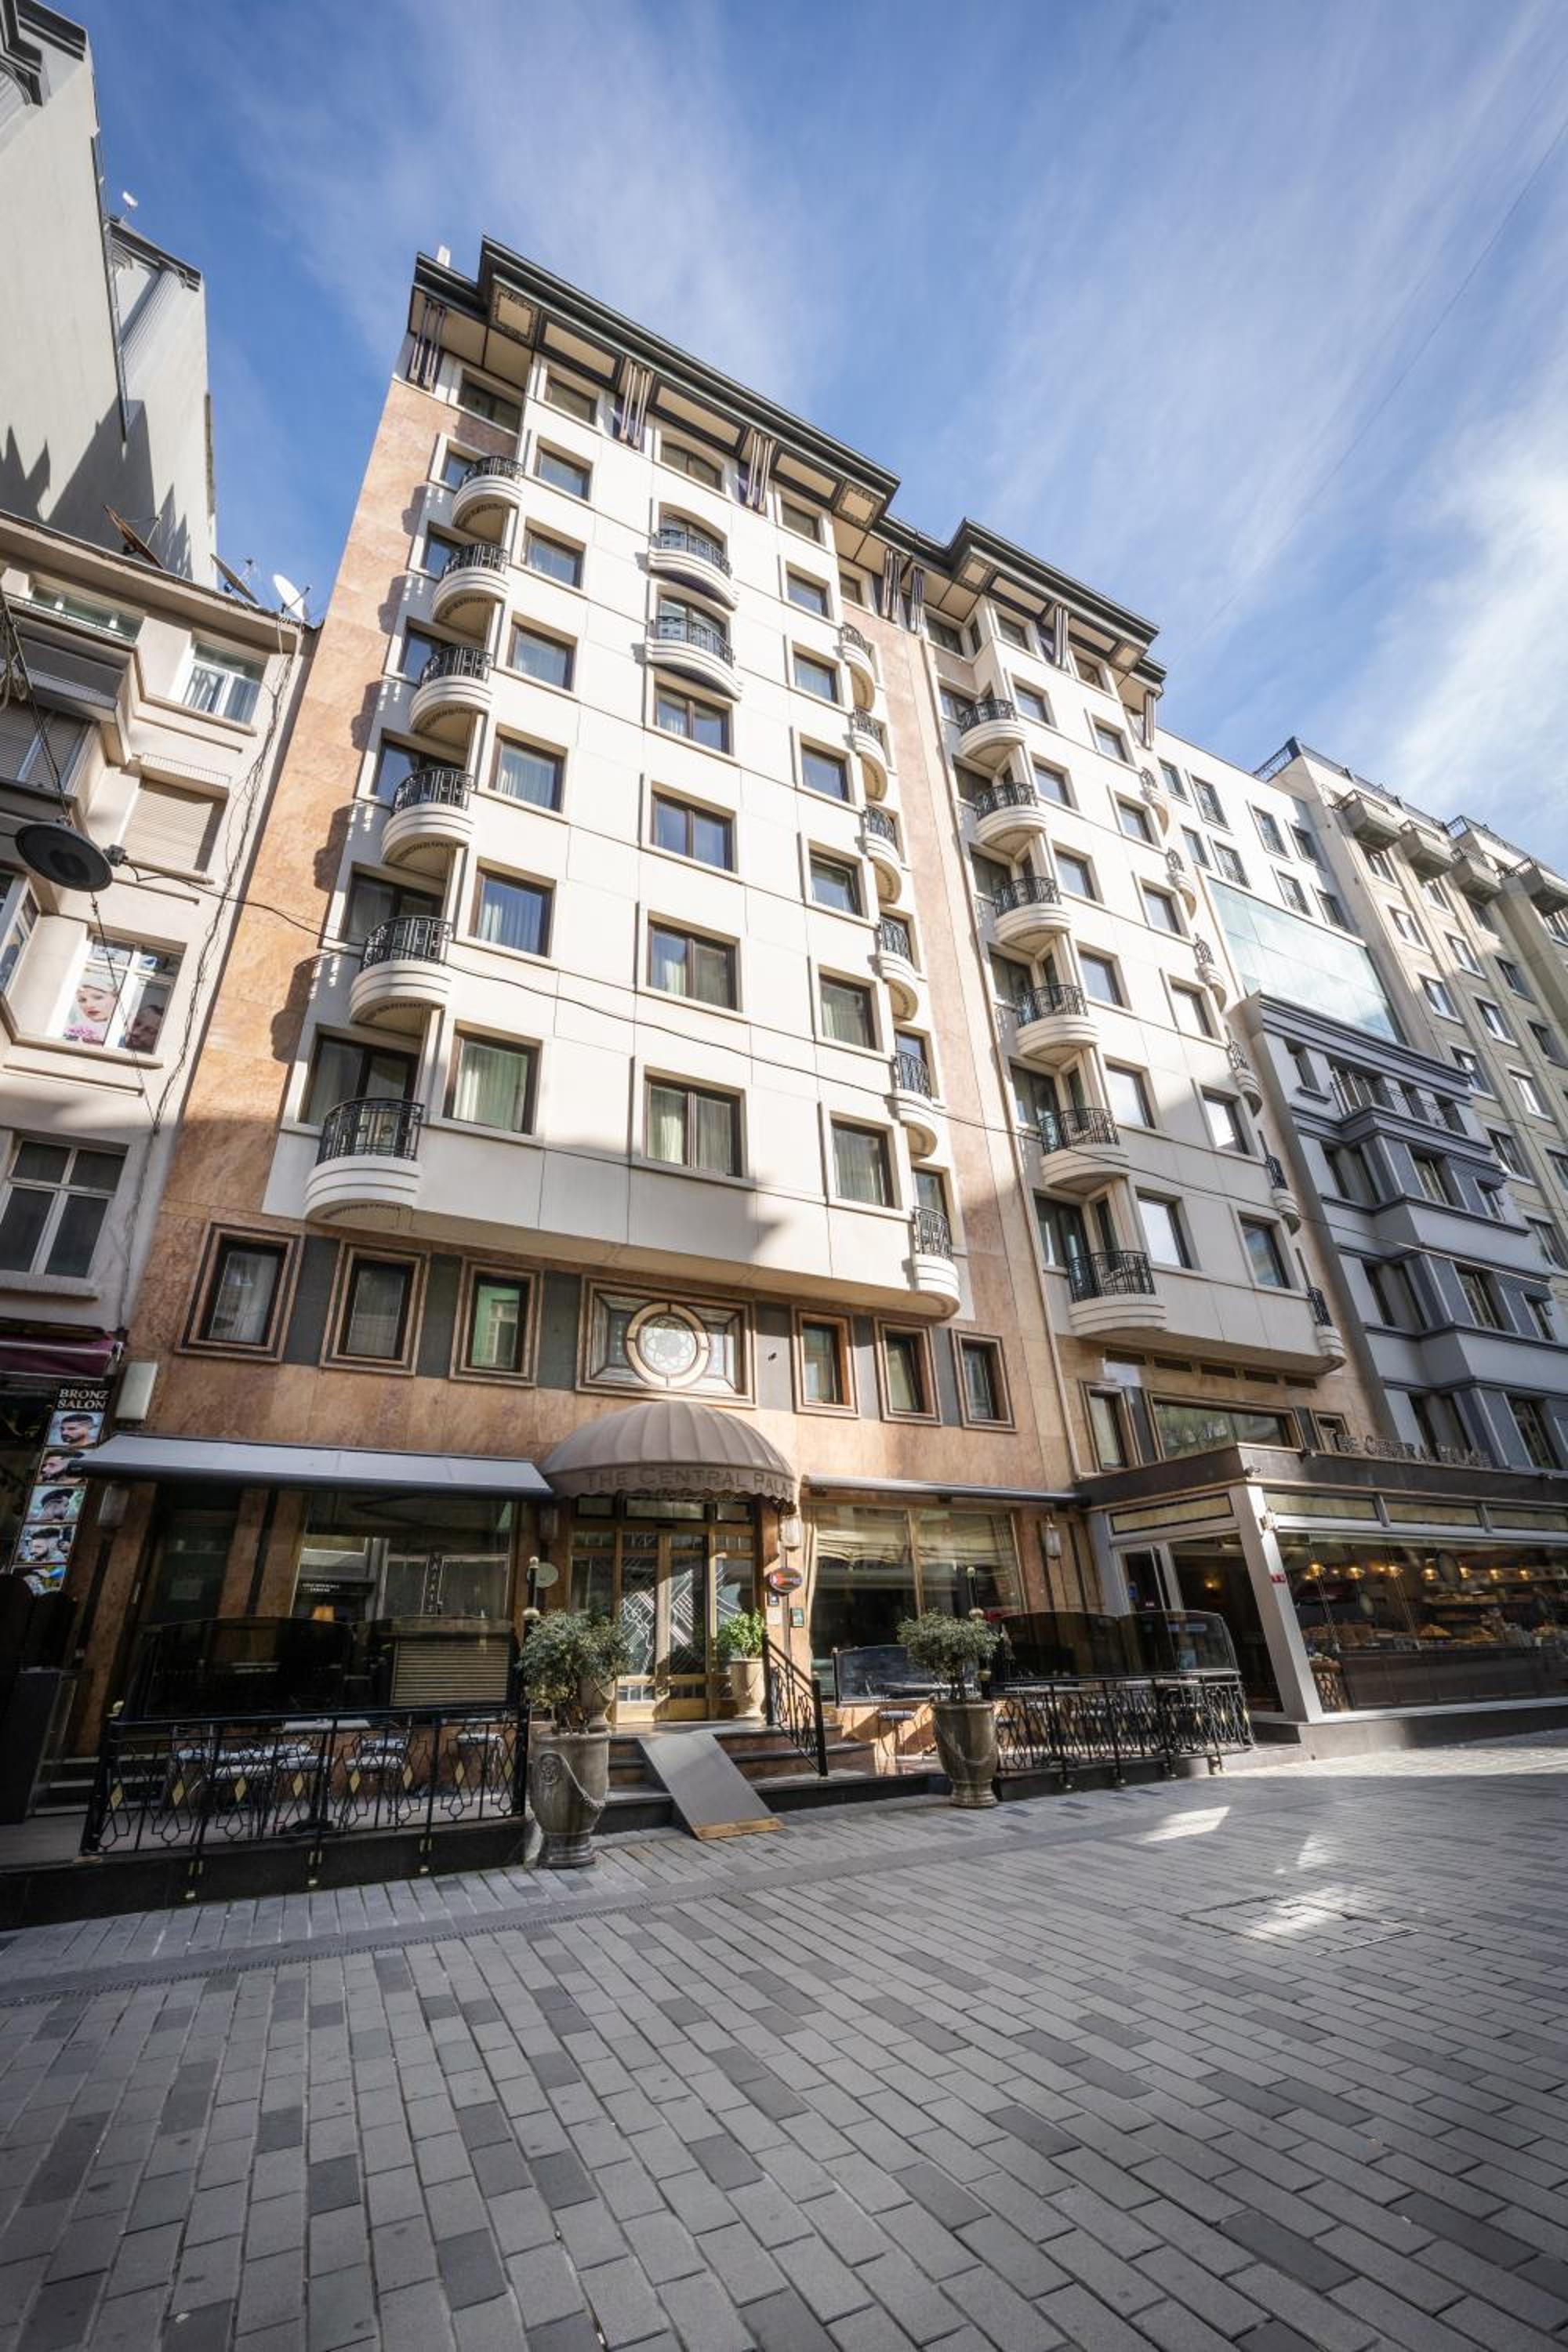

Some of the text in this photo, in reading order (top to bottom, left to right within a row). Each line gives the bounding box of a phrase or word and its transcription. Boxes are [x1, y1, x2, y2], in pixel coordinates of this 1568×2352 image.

[59, 1388, 109, 1399] BRONZ
[57, 1399, 106, 1409] SALON
[586, 1472, 627, 1489] THE
[639, 1467, 746, 1488] CENTRAL
